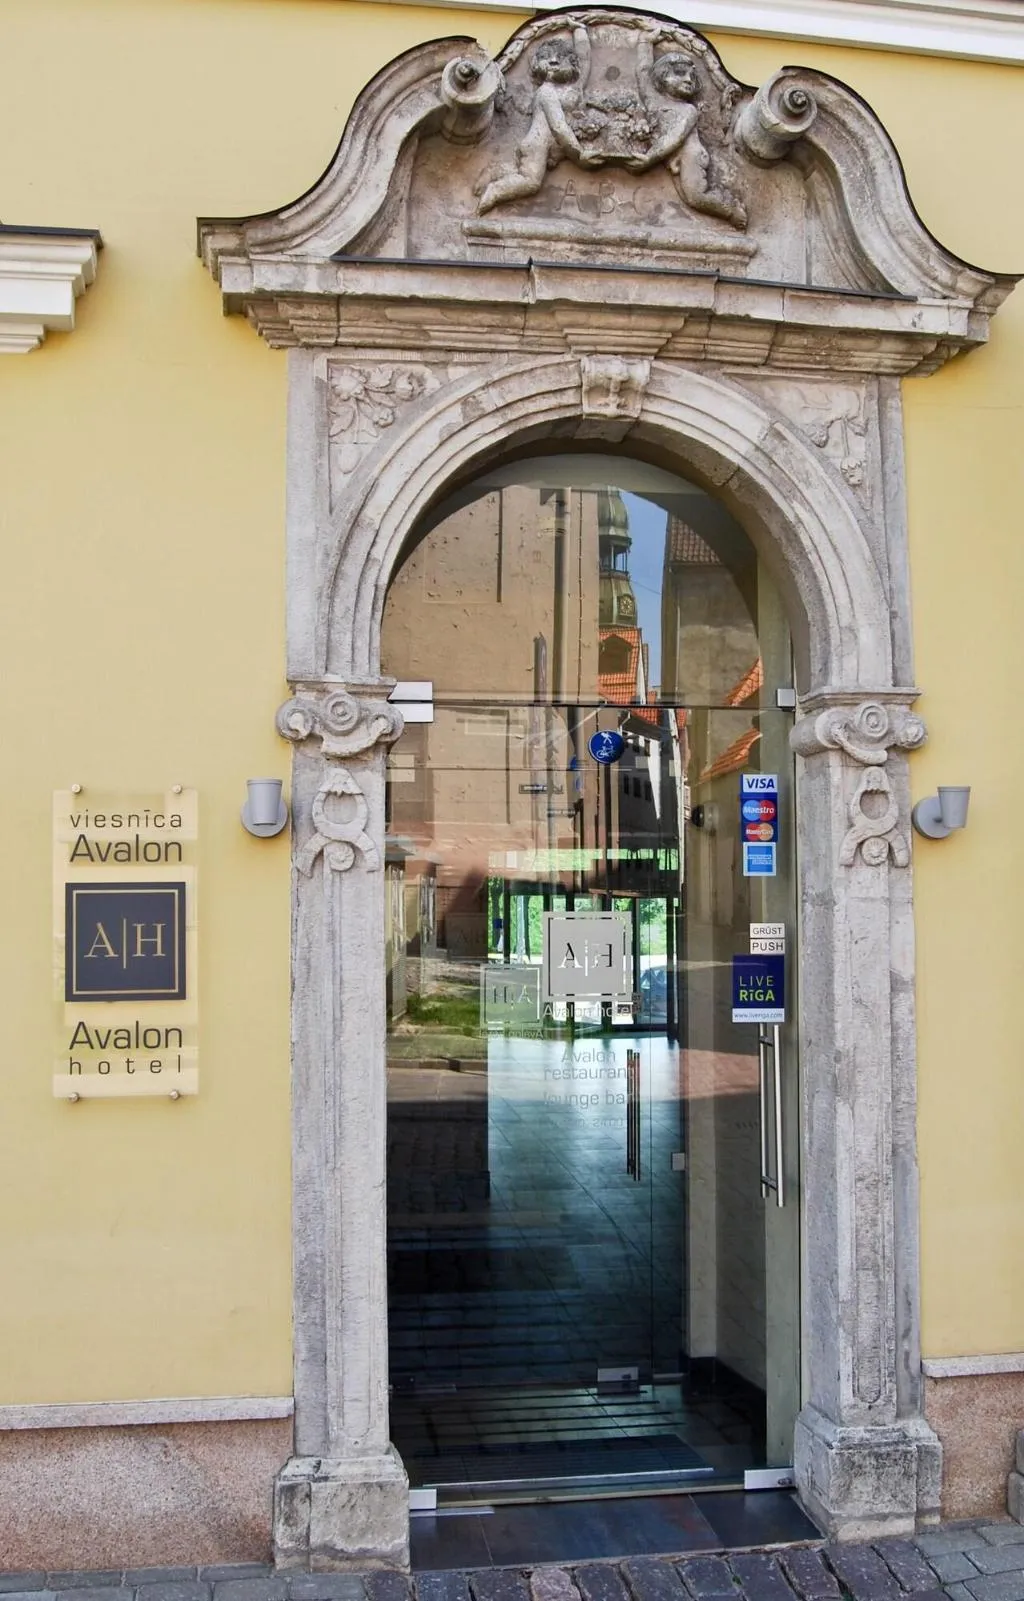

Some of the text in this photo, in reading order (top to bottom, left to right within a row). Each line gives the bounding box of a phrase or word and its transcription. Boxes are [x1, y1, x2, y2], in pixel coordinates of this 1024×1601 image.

[746, 778, 775, 790] VISA
[742, 805, 775, 815] Maestro
[69, 809, 183, 828] viesnīca
[68, 833, 183, 863] Avalon
[751, 942, 784, 952] PUSH
[739, 975, 775, 987] LIVE
[542, 1002, 595, 1018] Avalon
[68, 1020, 183, 1050] Avalon
[561, 1047, 616, 1063] Avalon
[69, 1055, 181, 1076] hotel
